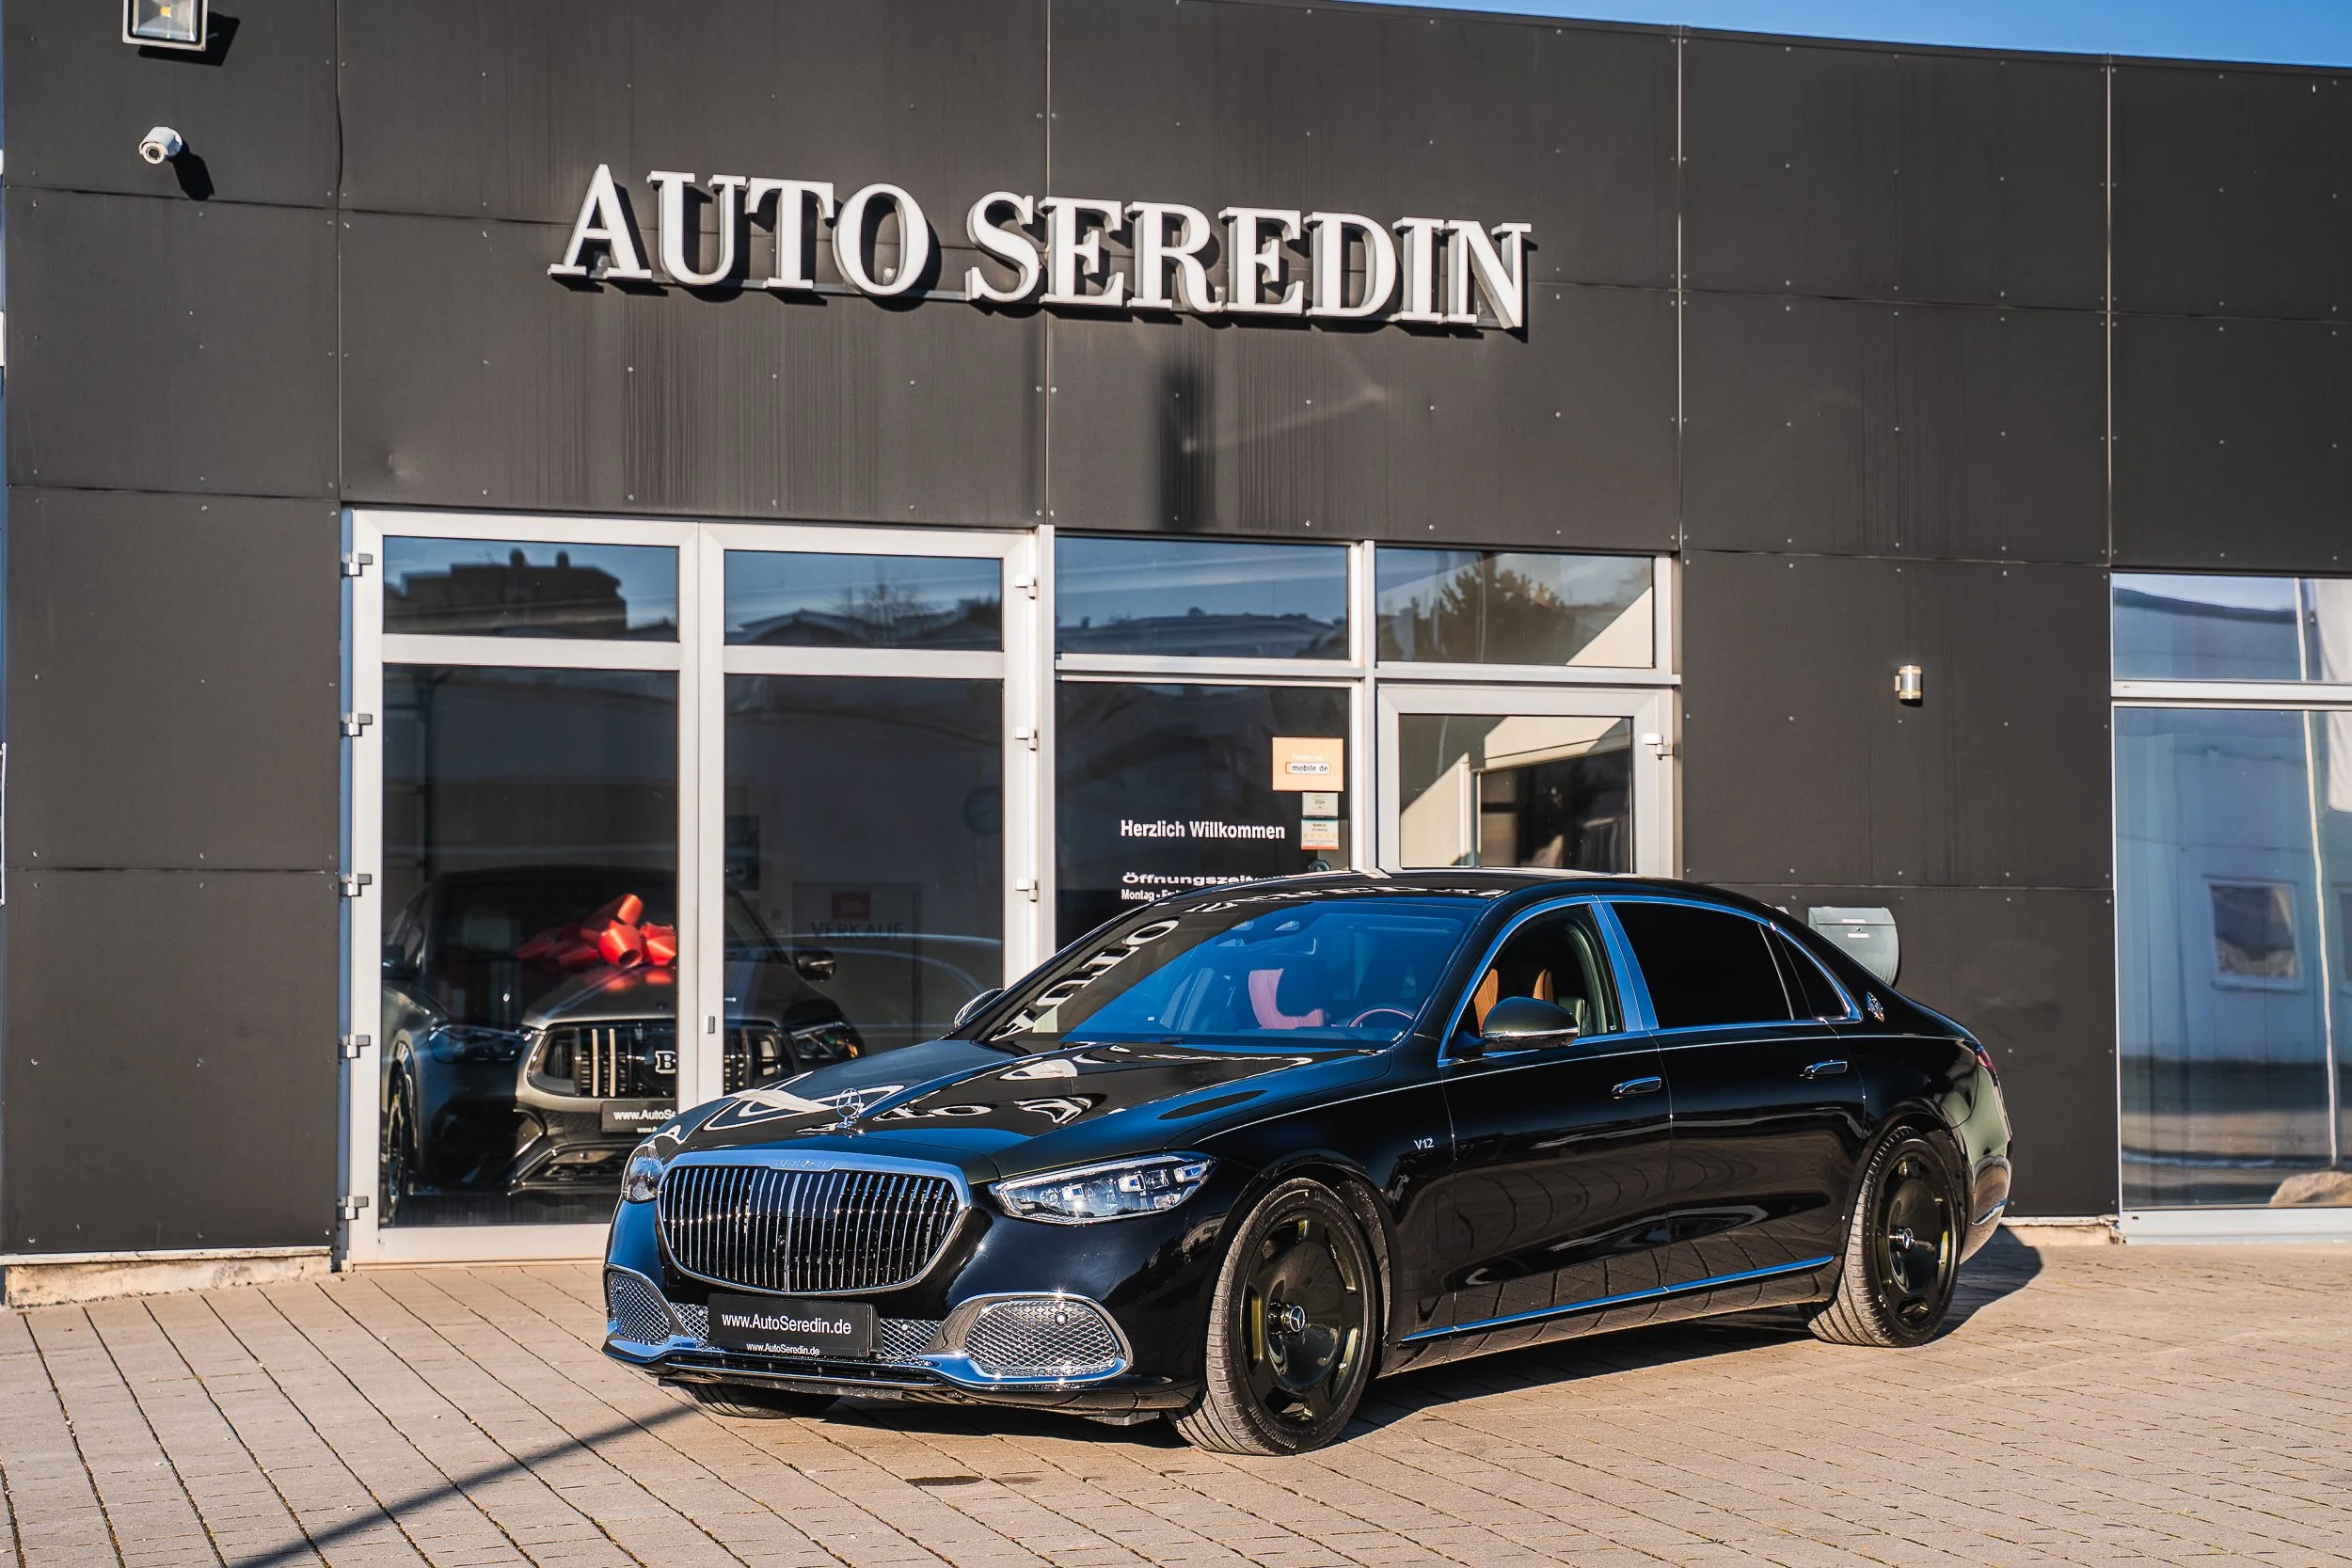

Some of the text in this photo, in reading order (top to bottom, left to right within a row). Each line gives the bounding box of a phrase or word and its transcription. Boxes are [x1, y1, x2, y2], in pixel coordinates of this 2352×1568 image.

[548, 164, 1533, 329] AUTO SEREDIN
[1120, 820, 1286, 840] Herzlich Willkommen
[1122, 872, 1270, 886] Öffnungszeit
[1121, 889, 1155, 902] Montag
[811, 922, 905, 941] VERKAUF
[1413, 1137, 1435, 1150] V12
[722, 1314, 851, 1334] www.AutoSeredin.de
[746, 1342, 819, 1355] www.AutoSeredin.de
